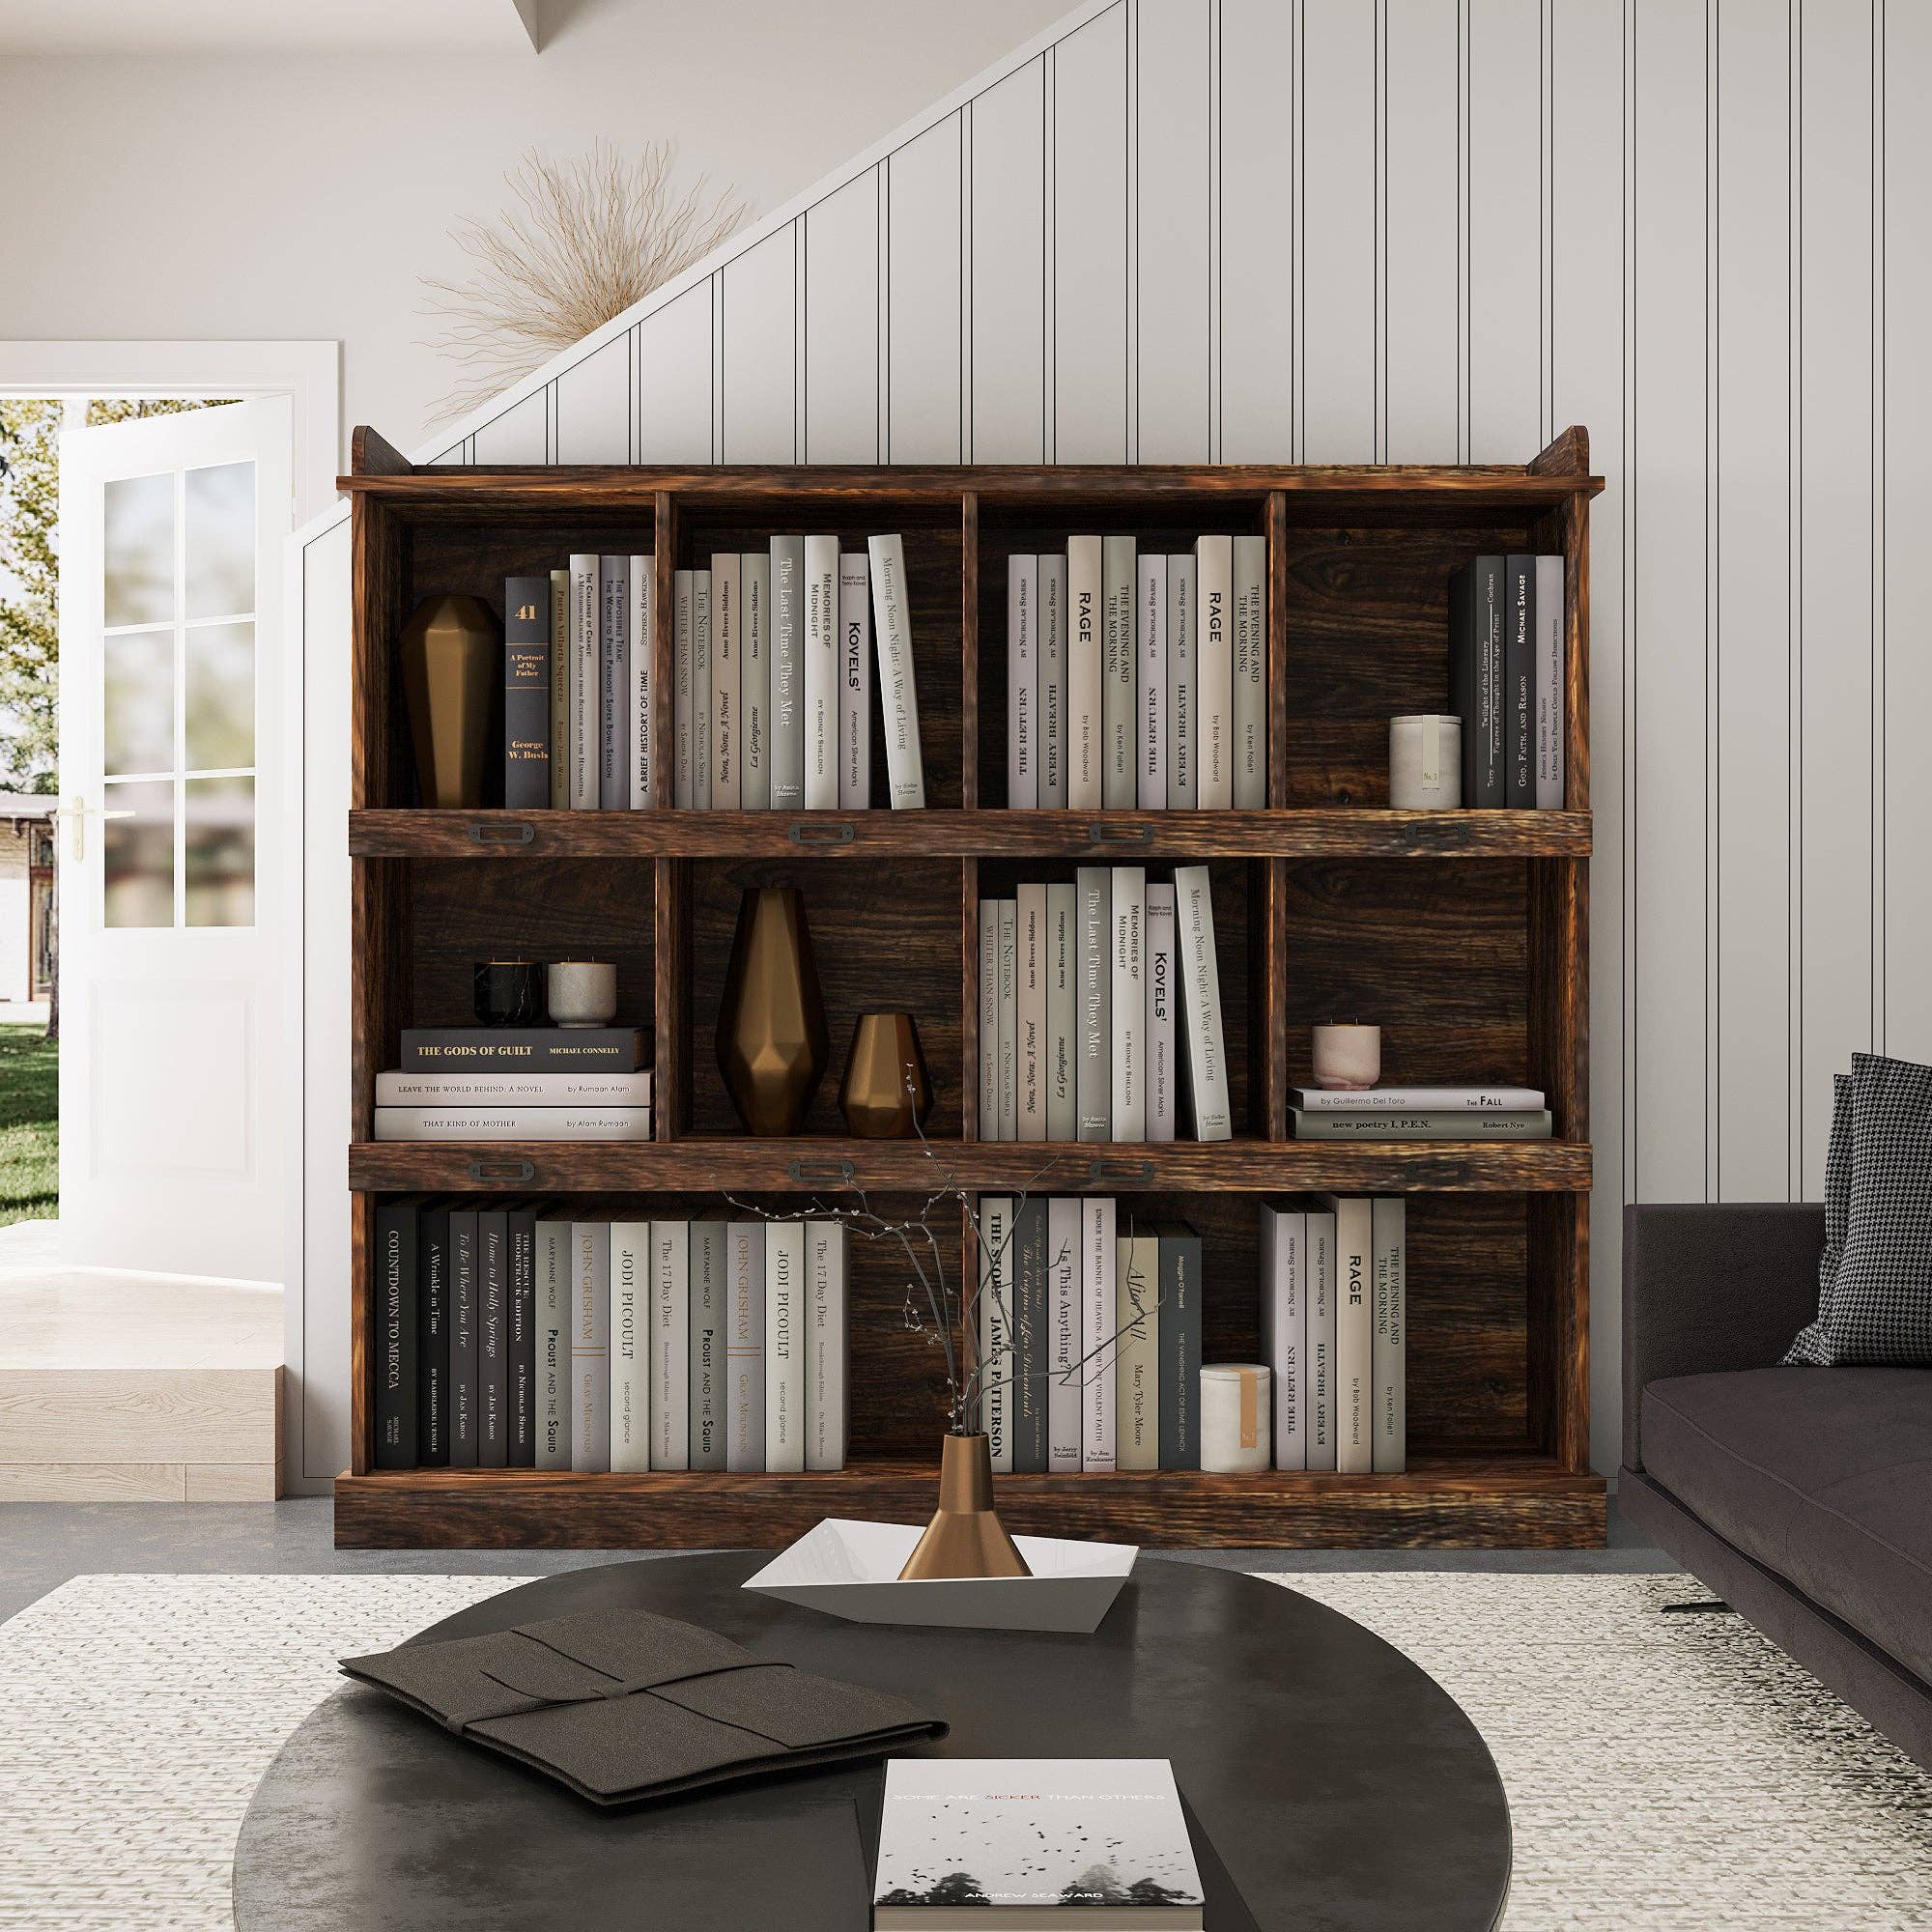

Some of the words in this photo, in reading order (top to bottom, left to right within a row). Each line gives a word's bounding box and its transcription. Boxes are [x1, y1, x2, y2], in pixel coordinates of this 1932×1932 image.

[779, 557, 793, 586] The
[881, 557, 895, 601] Morning
[779, 588, 793, 619] Last
[1109, 595, 1118, 617] THE
[1121, 585, 1129, 606] THE
[515, 606, 537, 620] 41
[887, 605, 898, 630] Noon
[1080, 592, 1092, 642] RAGE
[1209, 592, 1222, 642] RAGE
[779, 624, 793, 657] Time
[1109, 620, 1118, 672] MORNING
[1121, 611, 1129, 656] EVENING
[887, 634, 901, 666] Night:
[779, 663, 793, 696] They
[893, 668, 901, 677] A
[1121, 660, 1129, 683] AND
[640, 696, 648, 709] OF
[893, 678, 904, 701] Way
[779, 700, 793, 726] Met
[895, 703, 906, 714] of
[1049, 684, 1058, 738] BREATH
[1082, 715, 1090, 724] by
[895, 717, 907, 750] Living
[1116, 724, 1124, 734] by
[512, 741, 543, 750] George
[1116, 736, 1124, 750] Ken
[1049, 743, 1058, 786] EVERY
[1116, 752, 1124, 774] Follett
[640, 784, 648, 793] A
[1088, 889, 1100, 917] The
[1088, 918, 1100, 950] Last
[1088, 954, 1100, 988] Time
[1088, 994, 1100, 1026] They
[417, 1047, 441, 1056] THE
[444, 1047, 477, 1056] GODS
[479, 1047, 496, 1056] OF
[498, 1047, 533, 1056] GUILT
[1088, 1032, 1100, 1059] Met
[1057, 1086, 1066, 1098] La
[1356, 1121, 1388, 1130] poetry
[1483, 1121, 1508, 1129] Robert
[1511, 1121, 1525, 1129] Nye
[460, 1233, 469, 1245] To
[991, 1213, 1002, 1244] THE
[460, 1250, 469, 1263] Be
[486, 1233, 498, 1264] Home
[581, 1235, 593, 1272] JOHN
[661, 1240, 672, 1261] The
[1061, 1249, 1071, 1262] Is
[388, 1231, 399, 1318] COUNTDOWN
[431, 1255, 440, 1293] Wrinkle
[486, 1268, 498, 1278] to
[621, 1250, 634, 1286] JODI
[661, 1265, 672, 1277] 17
[991, 1249, 1002, 1299] STORE
[1061, 1267, 1071, 1296] This
[1350, 1255, 1362, 1305] RAGE
[460, 1267, 469, 1301] Where
[486, 1282, 498, 1313] Holly
[661, 1281, 672, 1301] Day
[1128, 1267, 1146, 1311] After
[431, 1298, 440, 1307] in
[460, 1306, 469, 1323] You
[581, 1276, 593, 1340] GRISHAM
[388, 1321, 399, 1339] TO
[431, 1309, 440, 1335] Time
[621, 1293, 634, 1360] PICOULT
[661, 1306, 672, 1328] Diet
[1130, 1314, 1146, 1340] All
[460, 1327, 469, 1350] Are
[486, 1315, 498, 1358] Springs
[991, 1317, 1002, 1366] JAMES
[1058, 1300, 1071, 1370] Anything?
[388, 1343, 399, 1389] MECCA
[1134, 1364, 1144, 1389] Mary
[991, 1371, 1002, 1458] PATTERSON
[1134, 1391, 1144, 1415] Tyler
[1134, 1418, 1144, 1446] Moore
